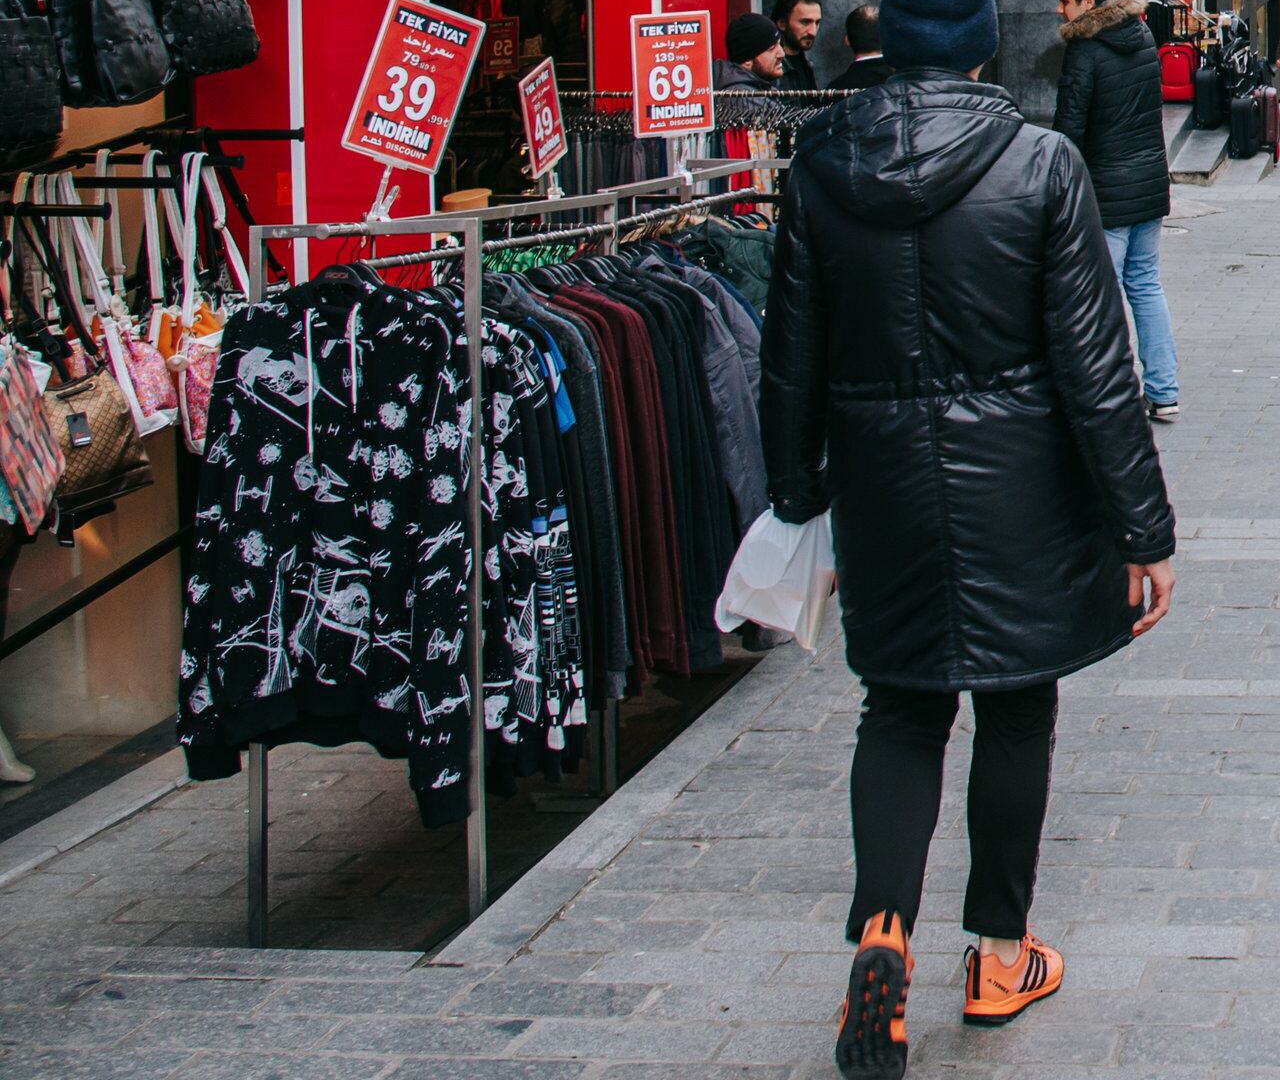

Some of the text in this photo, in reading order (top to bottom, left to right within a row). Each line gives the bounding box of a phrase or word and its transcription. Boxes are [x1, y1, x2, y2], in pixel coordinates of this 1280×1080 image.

[398, 10, 468, 46] TEK FİYAT
[640, 21, 700, 37] TEK FİYAT
[651, 101, 703, 120] İNDİRİM
[367, 111, 432, 151] İNDİRİM
[669, 117, 704, 127] DISCOUNT
[385, 141, 428, 161] DISCOUNT
